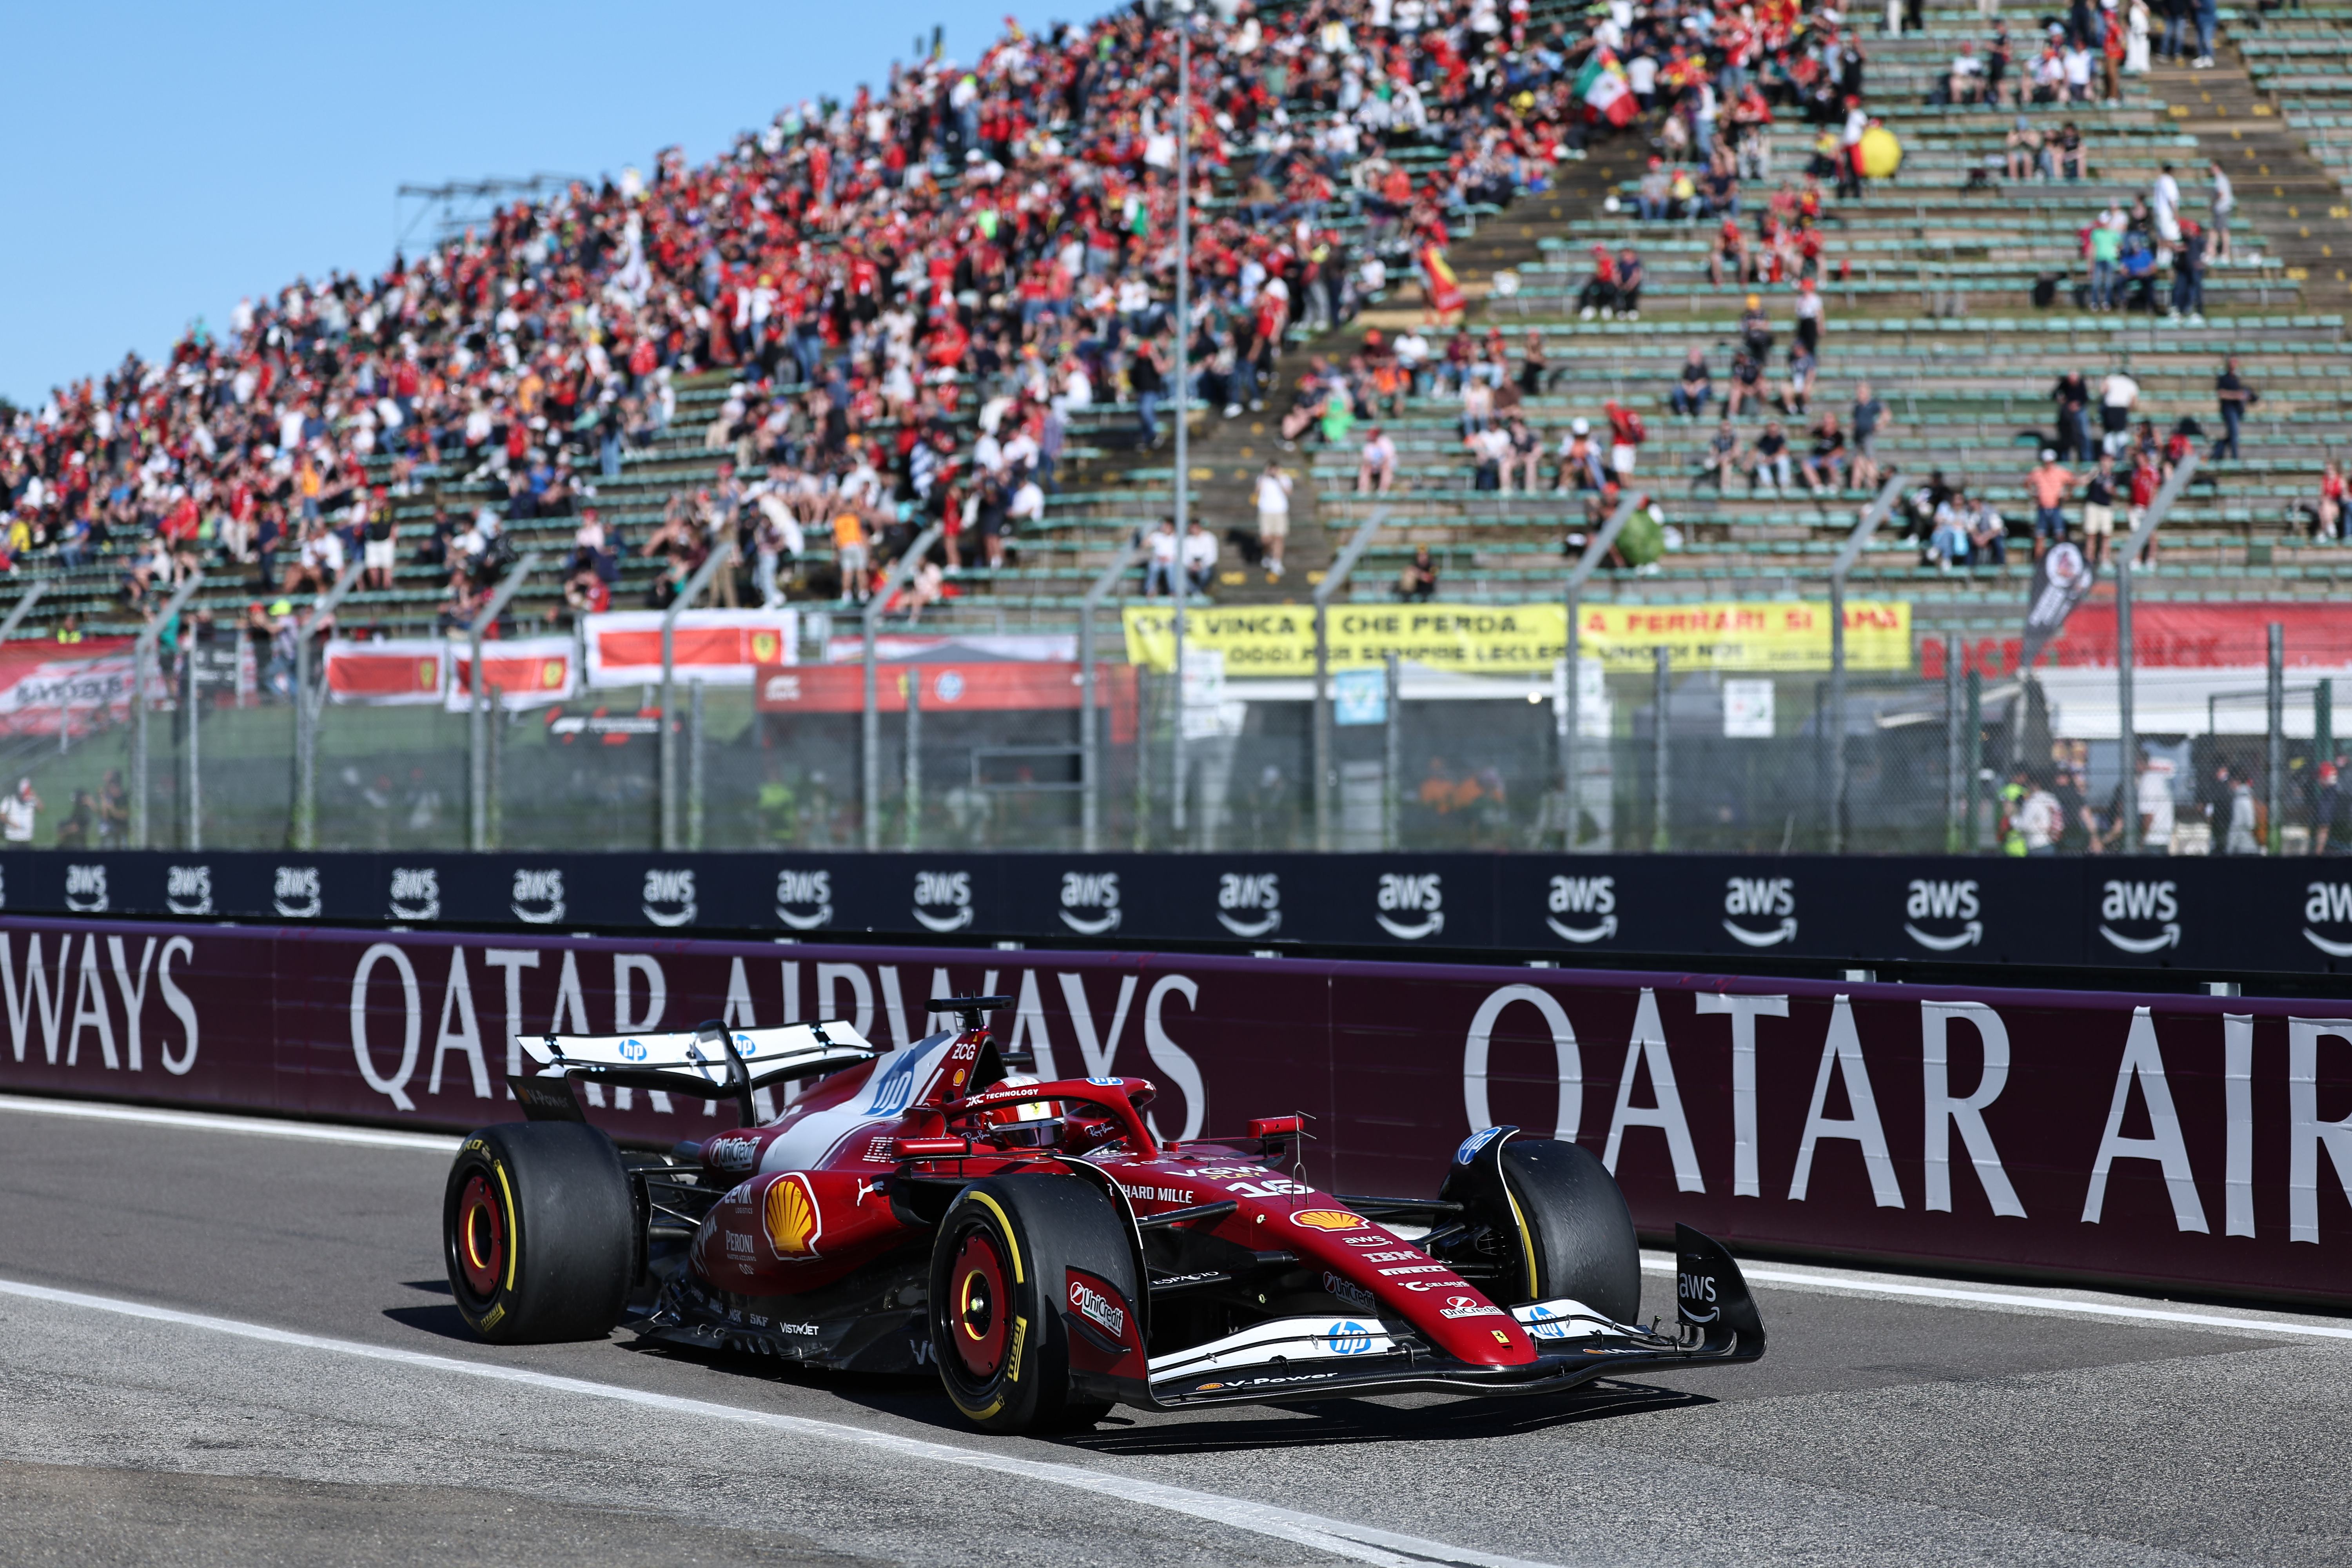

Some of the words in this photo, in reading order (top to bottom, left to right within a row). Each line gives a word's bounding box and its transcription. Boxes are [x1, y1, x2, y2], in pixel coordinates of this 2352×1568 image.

[1206, 616, 1295, 634] VINCA
[1342, 615, 1399, 634] CHE
[1627, 610, 1764, 632] FERRARI
[1785, 610, 1813, 631] SI
[1476, 646, 1568, 661] LECLER
[643, 869, 695, 902] aws
[777, 870, 831, 904] aws
[914, 871, 971, 906] aws
[1060, 872, 1119, 907] aws
[1218, 873, 1279, 909] aws
[1377, 873, 1442, 911] aws
[1548, 875, 1615, 914] aws
[1725, 877, 1794, 916] aws
[1907, 879, 1979, 920] aws
[2102, 880, 2178, 921] aws
[624, 1040, 645, 1061] hp
[951, 1043, 976, 1060] ZCG
[985, 1089, 1038, 1100] TECHNOLOGY
[1463, 983, 2028, 1218] QATAR
[719, 1137, 760, 1163] UniCredit
[1163, 1166, 1270, 1178] VGW
[1107, 1183, 1154, 1200] RHARD
[1157, 1187, 1194, 1204] MILLE
[1225, 1179, 1316, 1198] 16
[726, 1230, 754, 1254] PERONI
[1342, 1235, 1387, 1245] aws
[1361, 1250, 1423, 1263] IBM
[1378, 1265, 1448, 1276] PIRELLI
[1334, 1276, 1374, 1310] UniCredit
[1679, 1272, 1717, 1303] aws
[750, 1313, 768, 1327] SKF
[1084, 1288, 1124, 1331] UniCredit
[1442, 1306, 1501, 1317] UniCredit
[1007, 1314, 1027, 1383] PIRELLI
[1334, 1321, 1370, 1354] hp
[1225, 1372, 1338, 1387] V-Power
